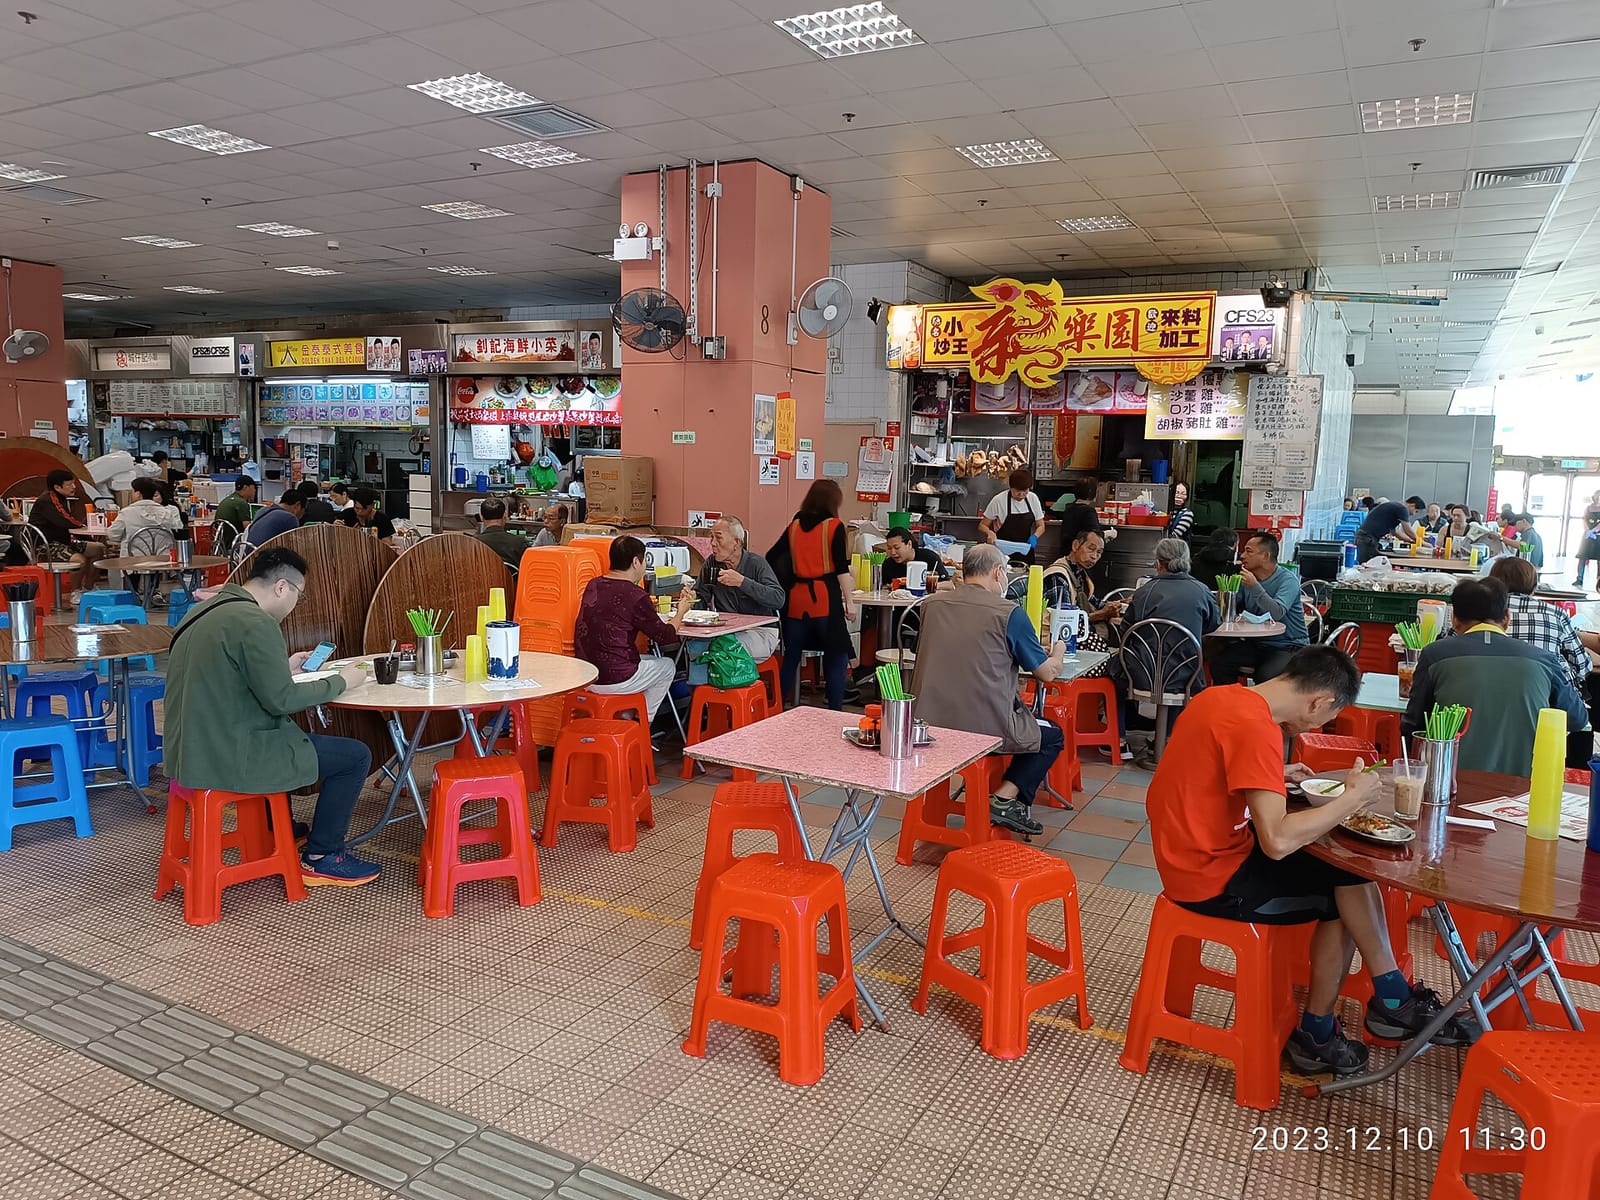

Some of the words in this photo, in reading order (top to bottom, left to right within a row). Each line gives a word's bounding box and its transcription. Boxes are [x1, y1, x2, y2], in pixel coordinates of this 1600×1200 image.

[760, 304, 769, 335] 8
[1160, 307, 1202, 327] 來料
[1224, 309, 1275, 324] CFS23
[476, 336, 558, 354] 釗記海鮮小菜
[1158, 329, 1200, 348] 加工
